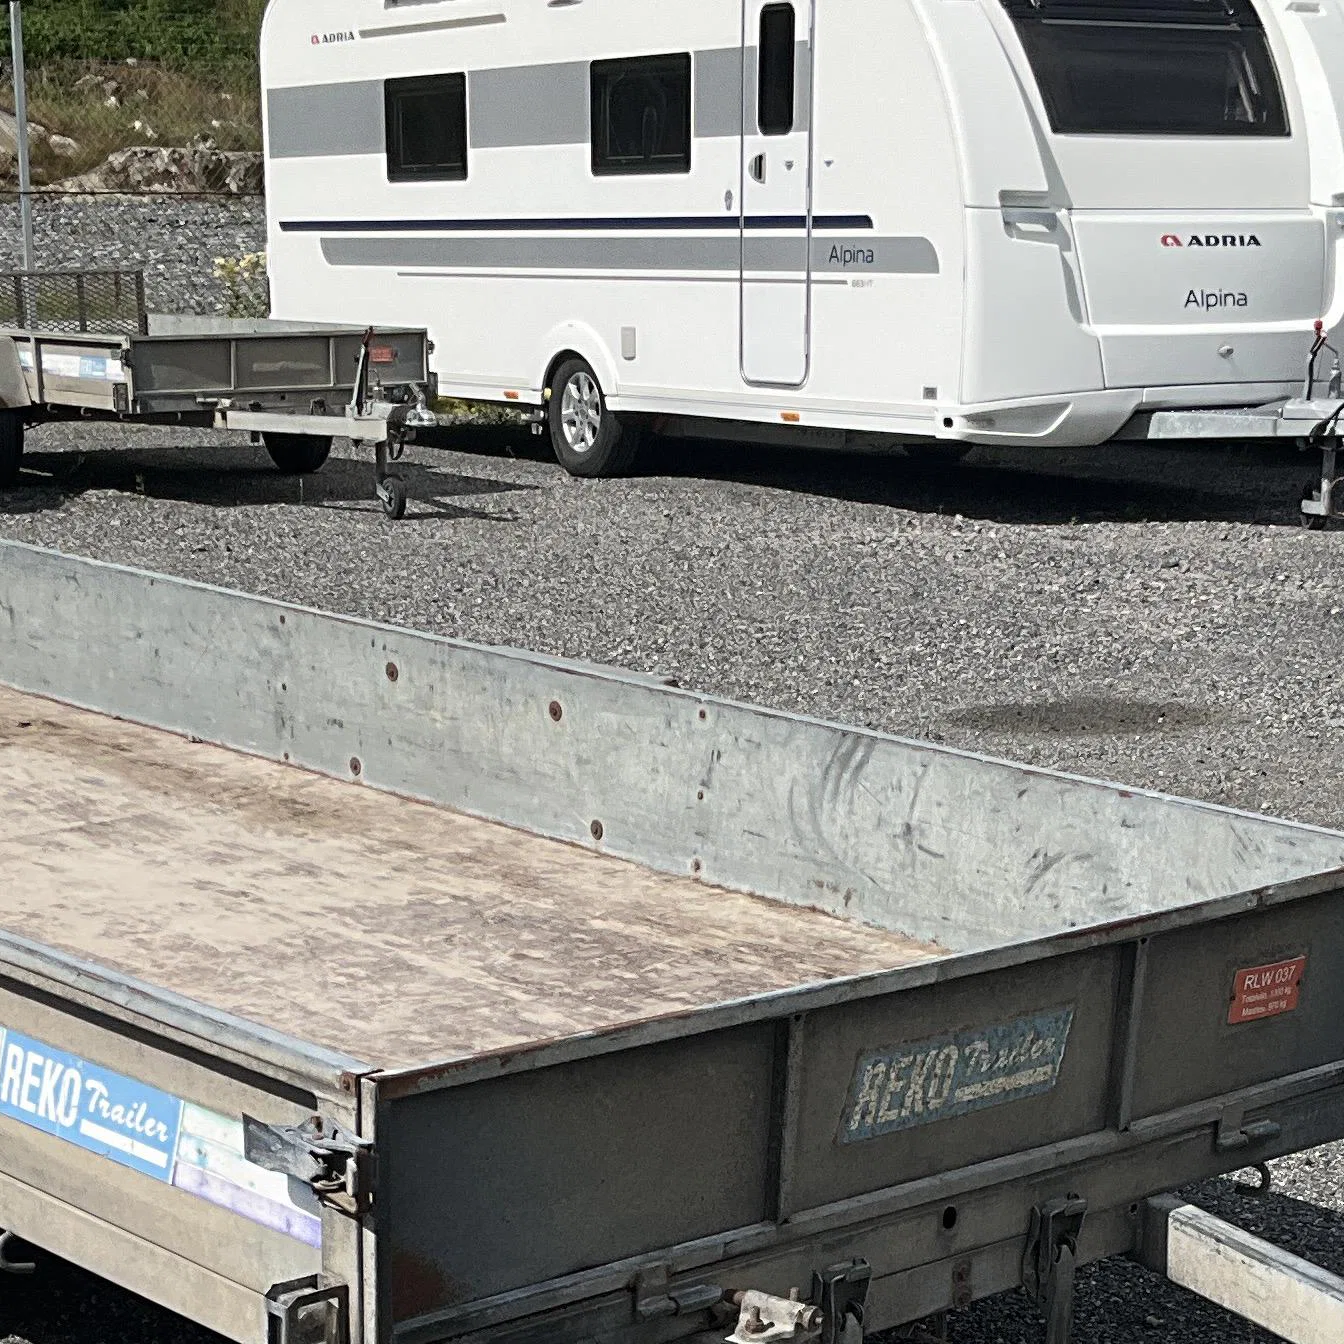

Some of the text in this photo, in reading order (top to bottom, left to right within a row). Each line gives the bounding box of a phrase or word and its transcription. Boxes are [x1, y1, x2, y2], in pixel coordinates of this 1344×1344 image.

[322, 31, 355, 43] ADRIA
[1187, 234, 1262, 247] ADRIA
[828, 244, 874, 267] Alpina
[1184, 288, 1248, 312] Alpina
[1243, 964, 1297, 991] RLW 037
[0, 1043, 169, 1143] REKO Trailer
[849, 1045, 958, 1131] REKO
